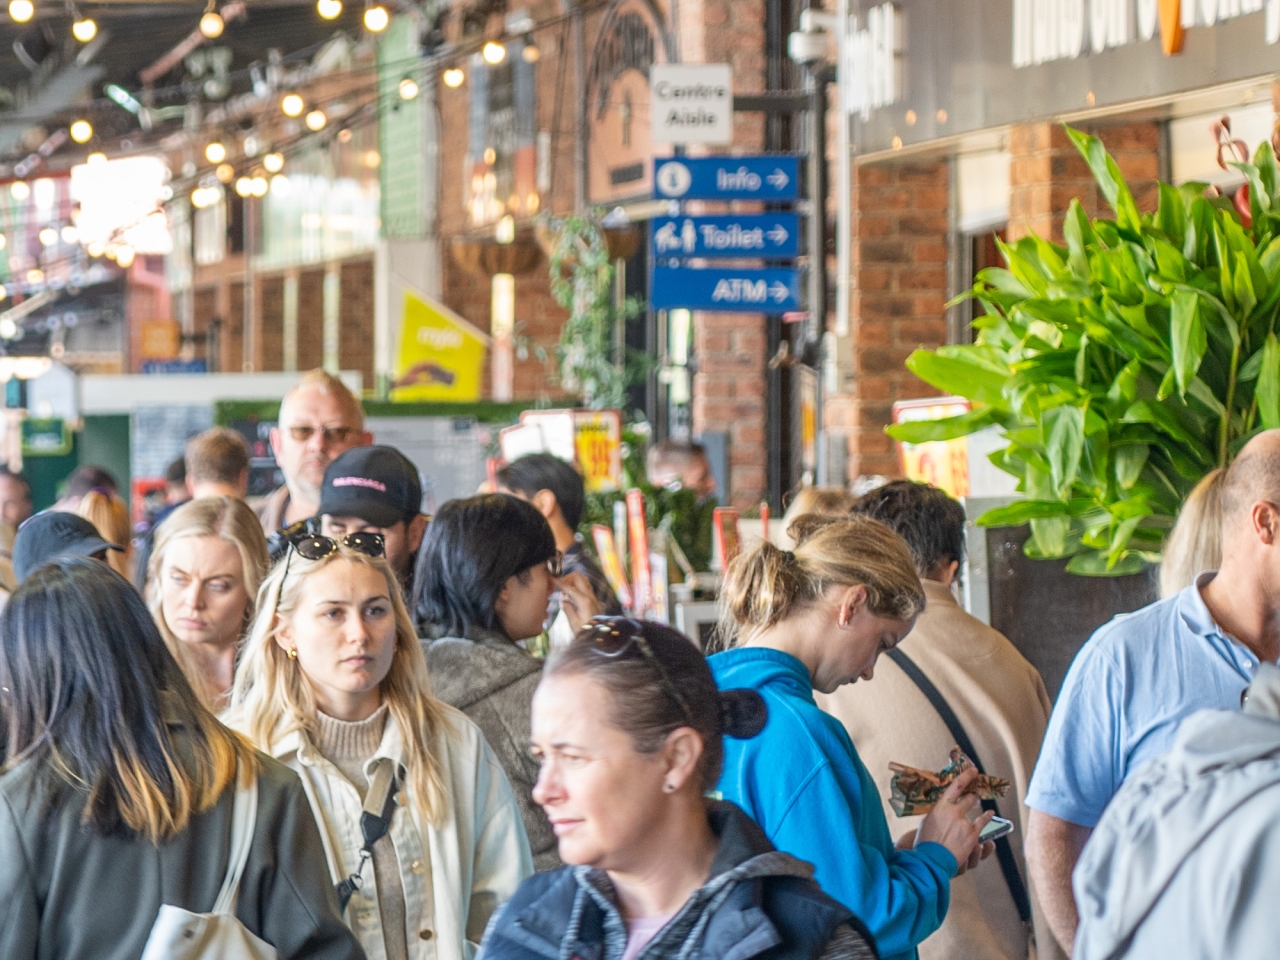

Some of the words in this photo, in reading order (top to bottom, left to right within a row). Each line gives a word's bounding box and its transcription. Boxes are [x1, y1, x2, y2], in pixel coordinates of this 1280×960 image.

[656, 80, 726, 100] Centre
[666, 107, 717, 127] Aisle
[717, 166, 762, 191] Info
[699, 223, 765, 249] Toilet
[712, 278, 768, 303] ATM
